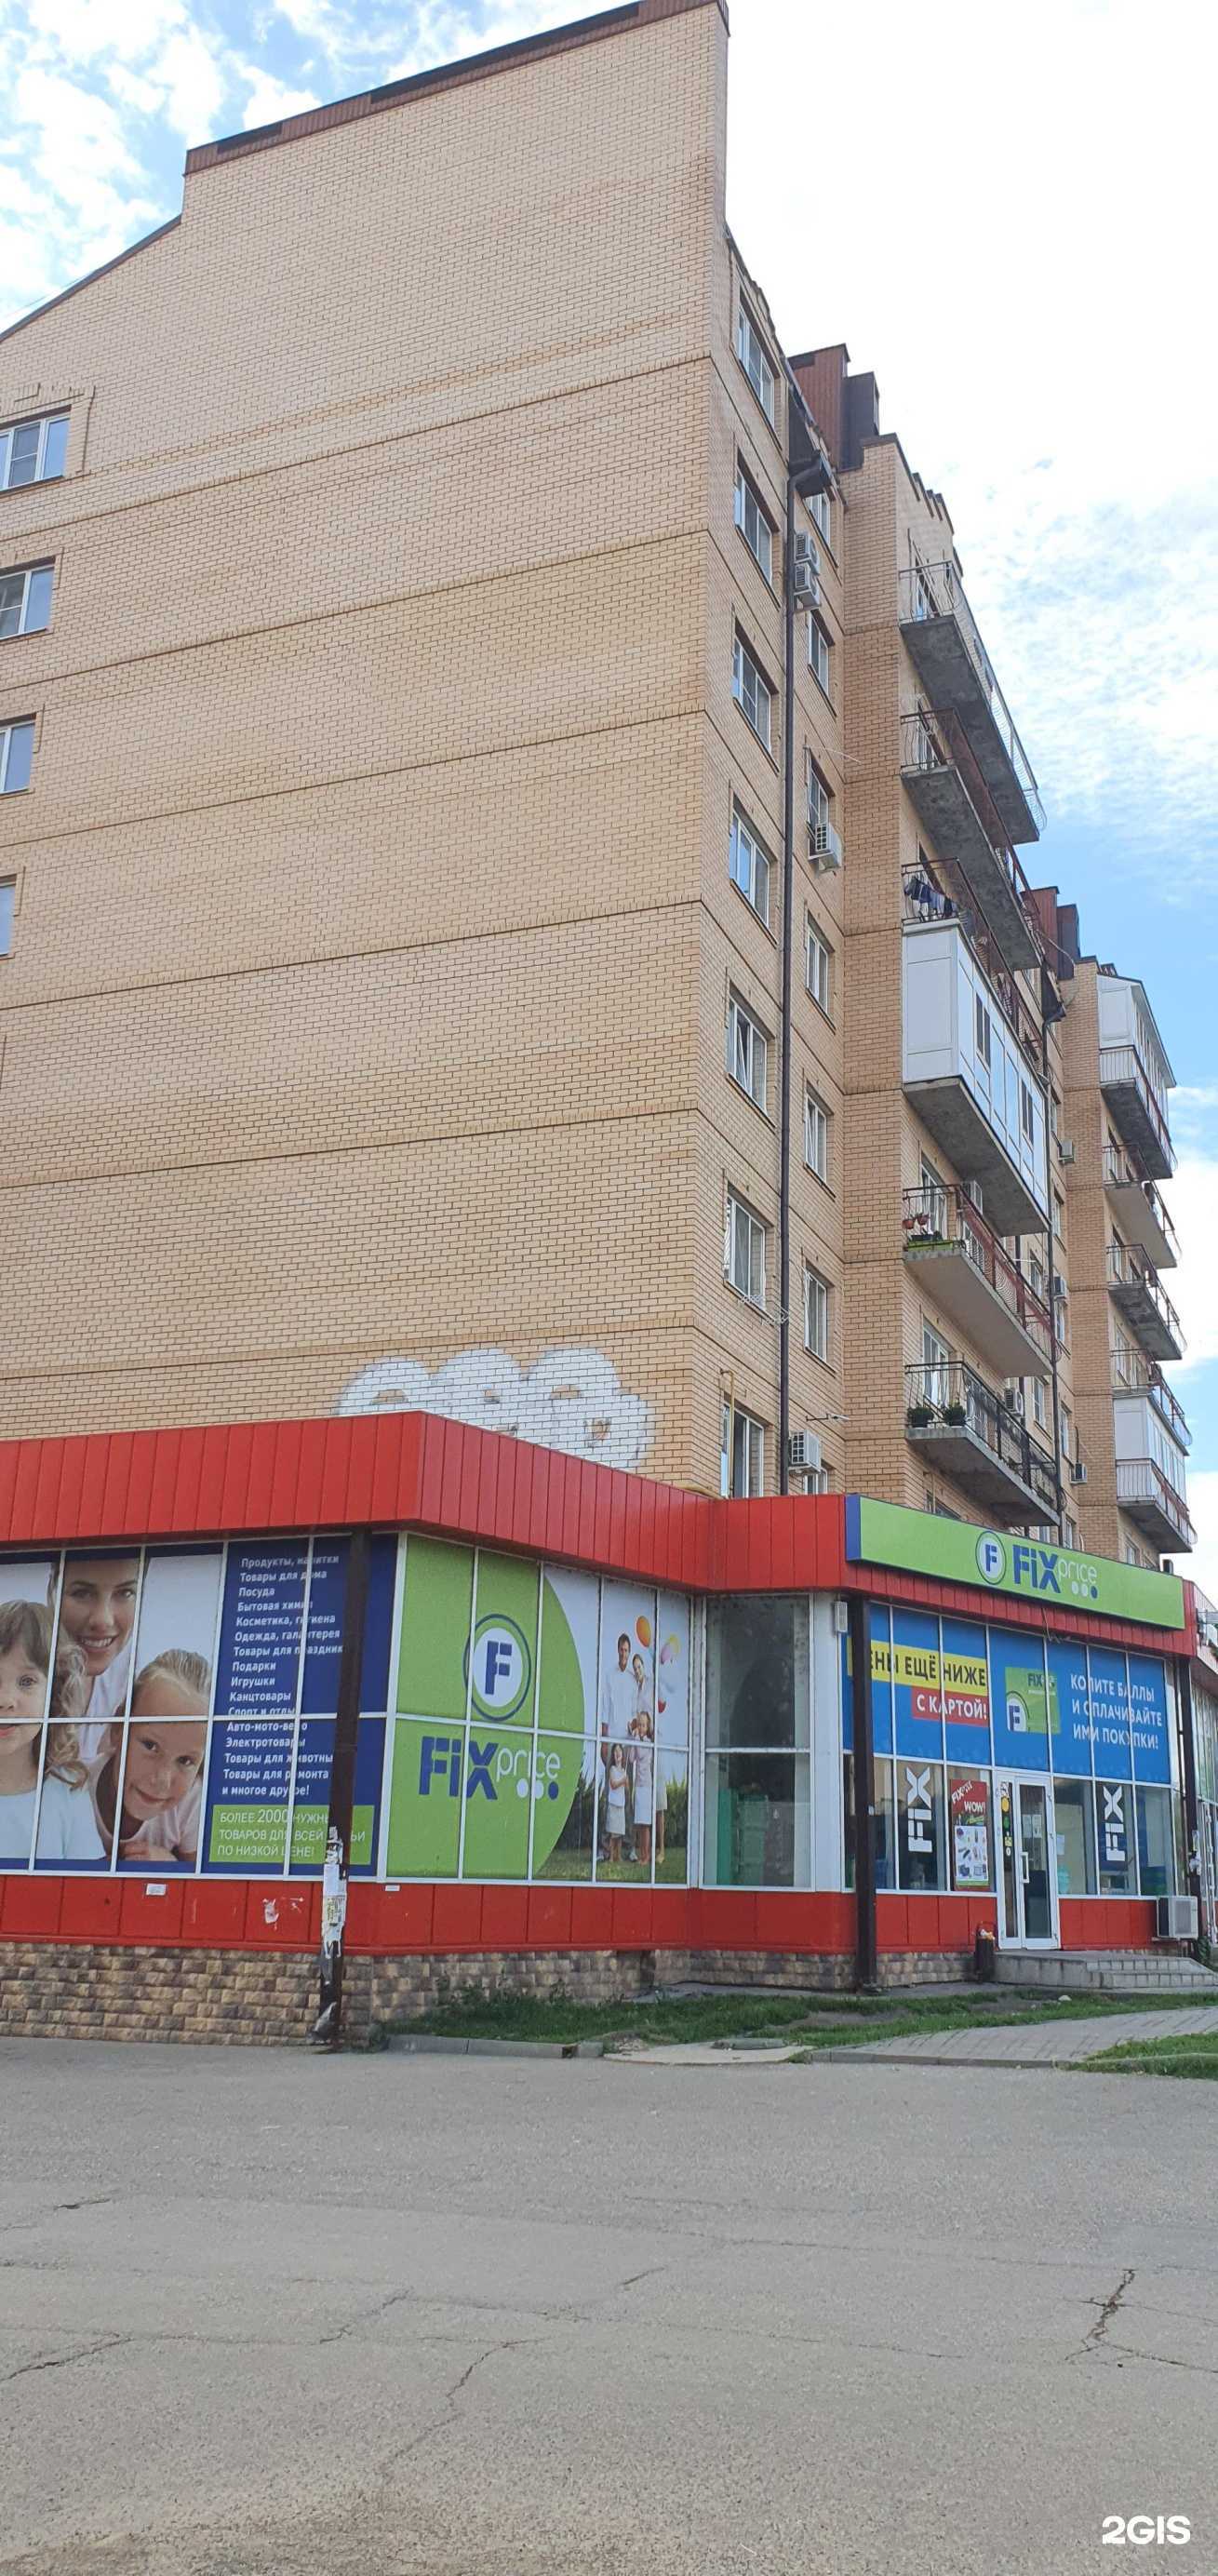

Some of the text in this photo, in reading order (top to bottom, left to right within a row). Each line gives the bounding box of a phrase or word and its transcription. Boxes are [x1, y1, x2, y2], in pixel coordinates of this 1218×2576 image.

[241, 1556, 340, 1569] Продукты, наитки
[240, 1572, 276, 1583] Товары
[279, 1572, 298, 1581] для
[1057, 1558, 1098, 1585] price
[238, 1588, 275, 1598] Посуда
[237, 1602, 279, 1612] Бытовая
[236, 1615, 336, 1627] Косметика, гииена
[234, 1631, 278, 1643] Одежда,
[234, 1646, 270, 1657] Товары
[273, 1647, 291, 1657] для
[232, 1661, 276, 1672] Подарки
[485, 1641, 512, 1695] F
[904, 1655, 937, 1681] ЕЩЁ
[942, 1661, 986, 1686] НИЖЕ
[231, 1677, 275, 1688] Игрушки
[1070, 1674, 1115, 1696] КОПИТЕ
[229, 1692, 291, 1703] Канцтовары
[930, 1696, 988, 1720] КАРТОЙ!
[1072, 1698, 1080, 1714] И
[226, 1722, 308, 1732] Авто-мото-вео
[1073, 1724, 1099, 1743] ИМИ
[224, 1753, 261, 1764] Товары
[263, 1754, 283, 1764] для
[496, 1747, 560, 1782] price
[223, 1769, 328, 1781] Товары для рмонта
[221, 1785, 310, 1798] и многое друое!
[964, 1801, 986, 1814] WOW!
[220, 1812, 255, 1823] БОЛЕЕ
[219, 1829, 266, 1841] ТОВАРОВ
[295, 1828, 324, 1841] ВСЕЙ
[217, 1845, 233, 1856] ПО
[236, 1844, 278, 1857] НИЗКОЙ
